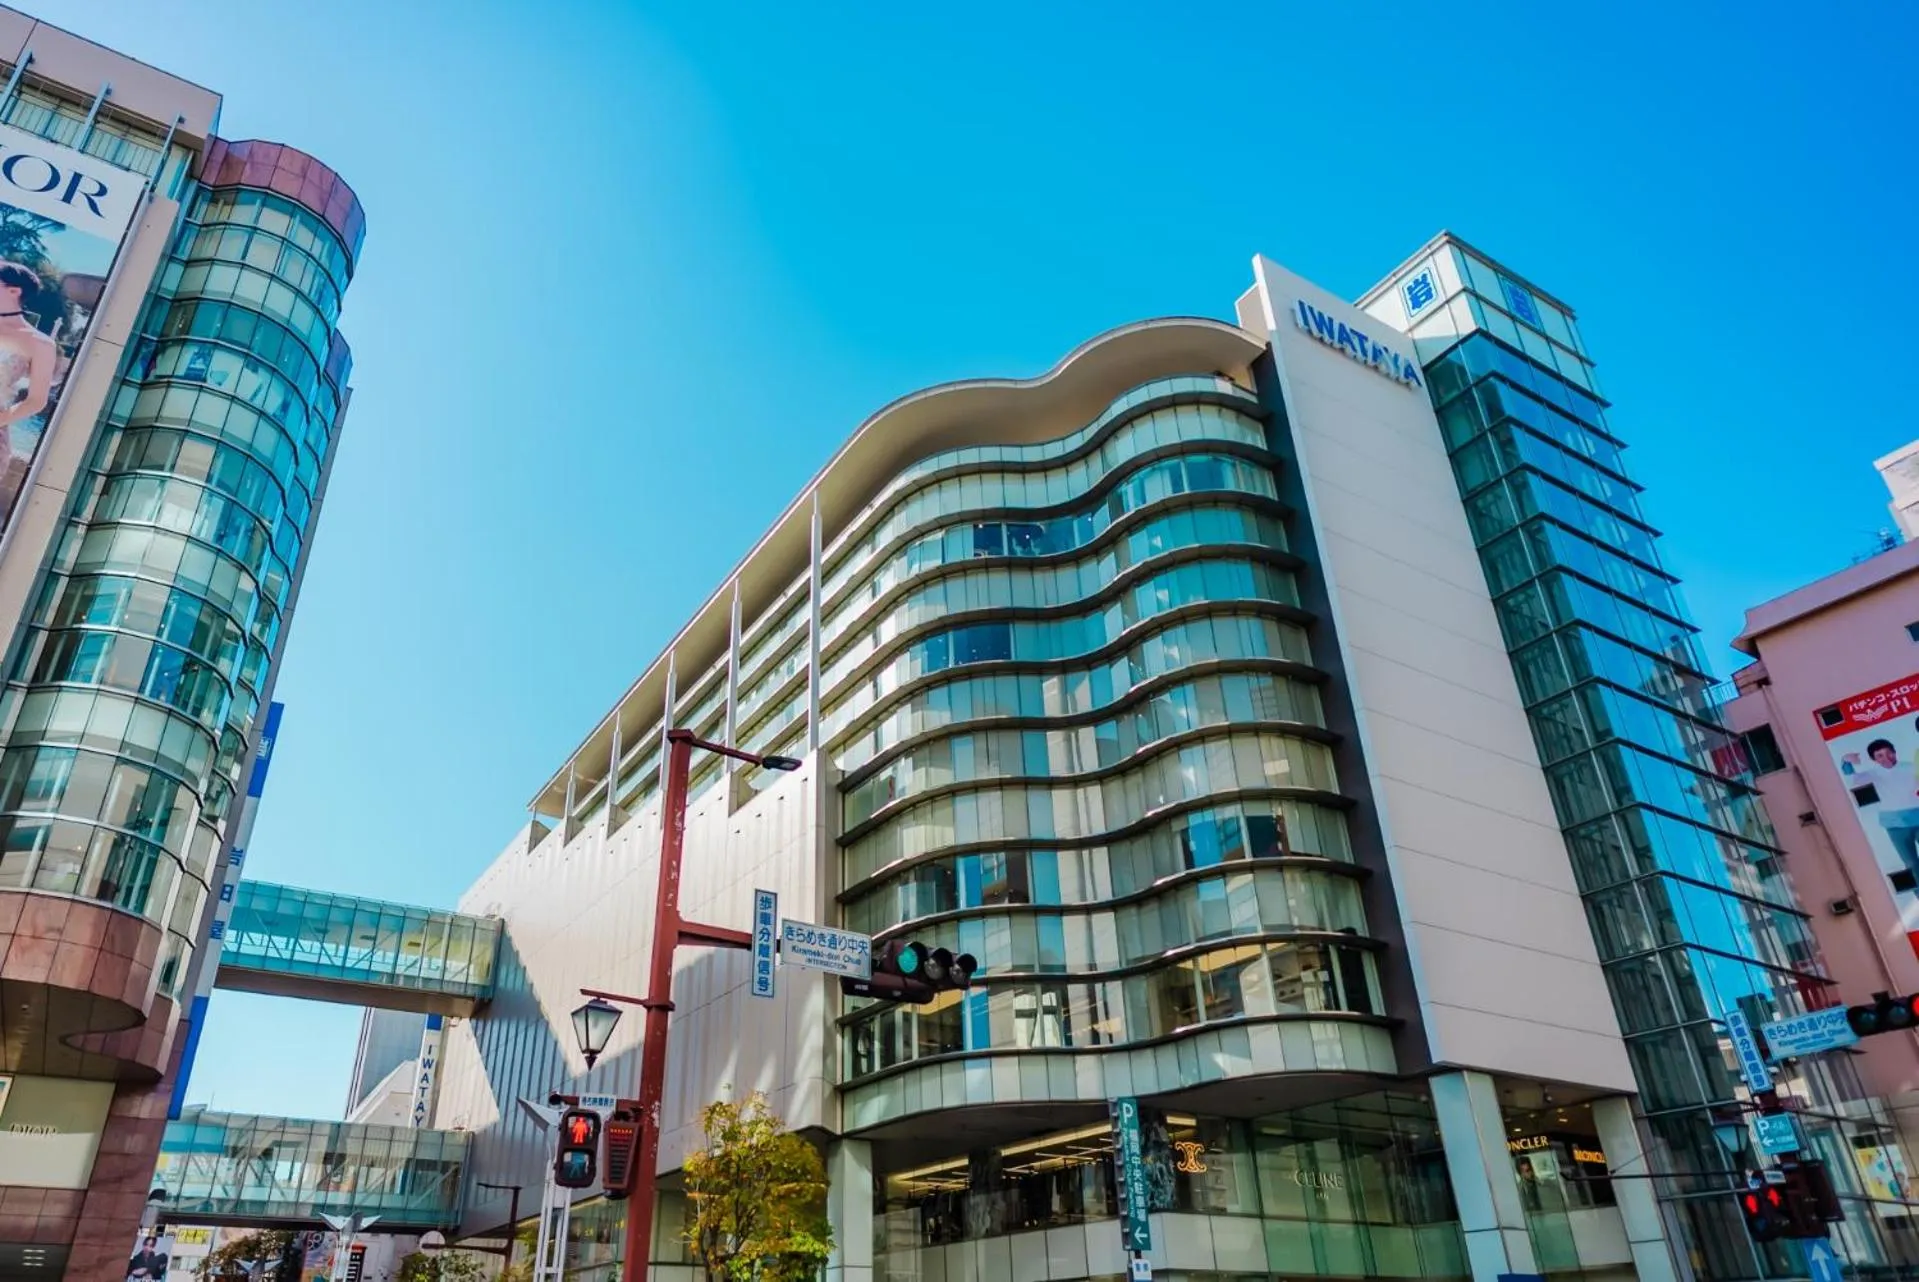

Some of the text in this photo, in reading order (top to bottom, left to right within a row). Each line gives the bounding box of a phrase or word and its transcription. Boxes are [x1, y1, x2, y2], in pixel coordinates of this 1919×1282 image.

[0, 143, 108, 219] OR
[1407, 271, 1434, 311] 岩
[1296, 299, 1423, 388] IWATAYA
[1848, 680, 1919, 712] パチンコ・スロッ
[757, 896, 772, 992] 歩車分離信号
[785, 926, 868, 956] きらめき通り中央
[1122, 1103, 1133, 1123] P
[1757, 1119, 1770, 1136] P
